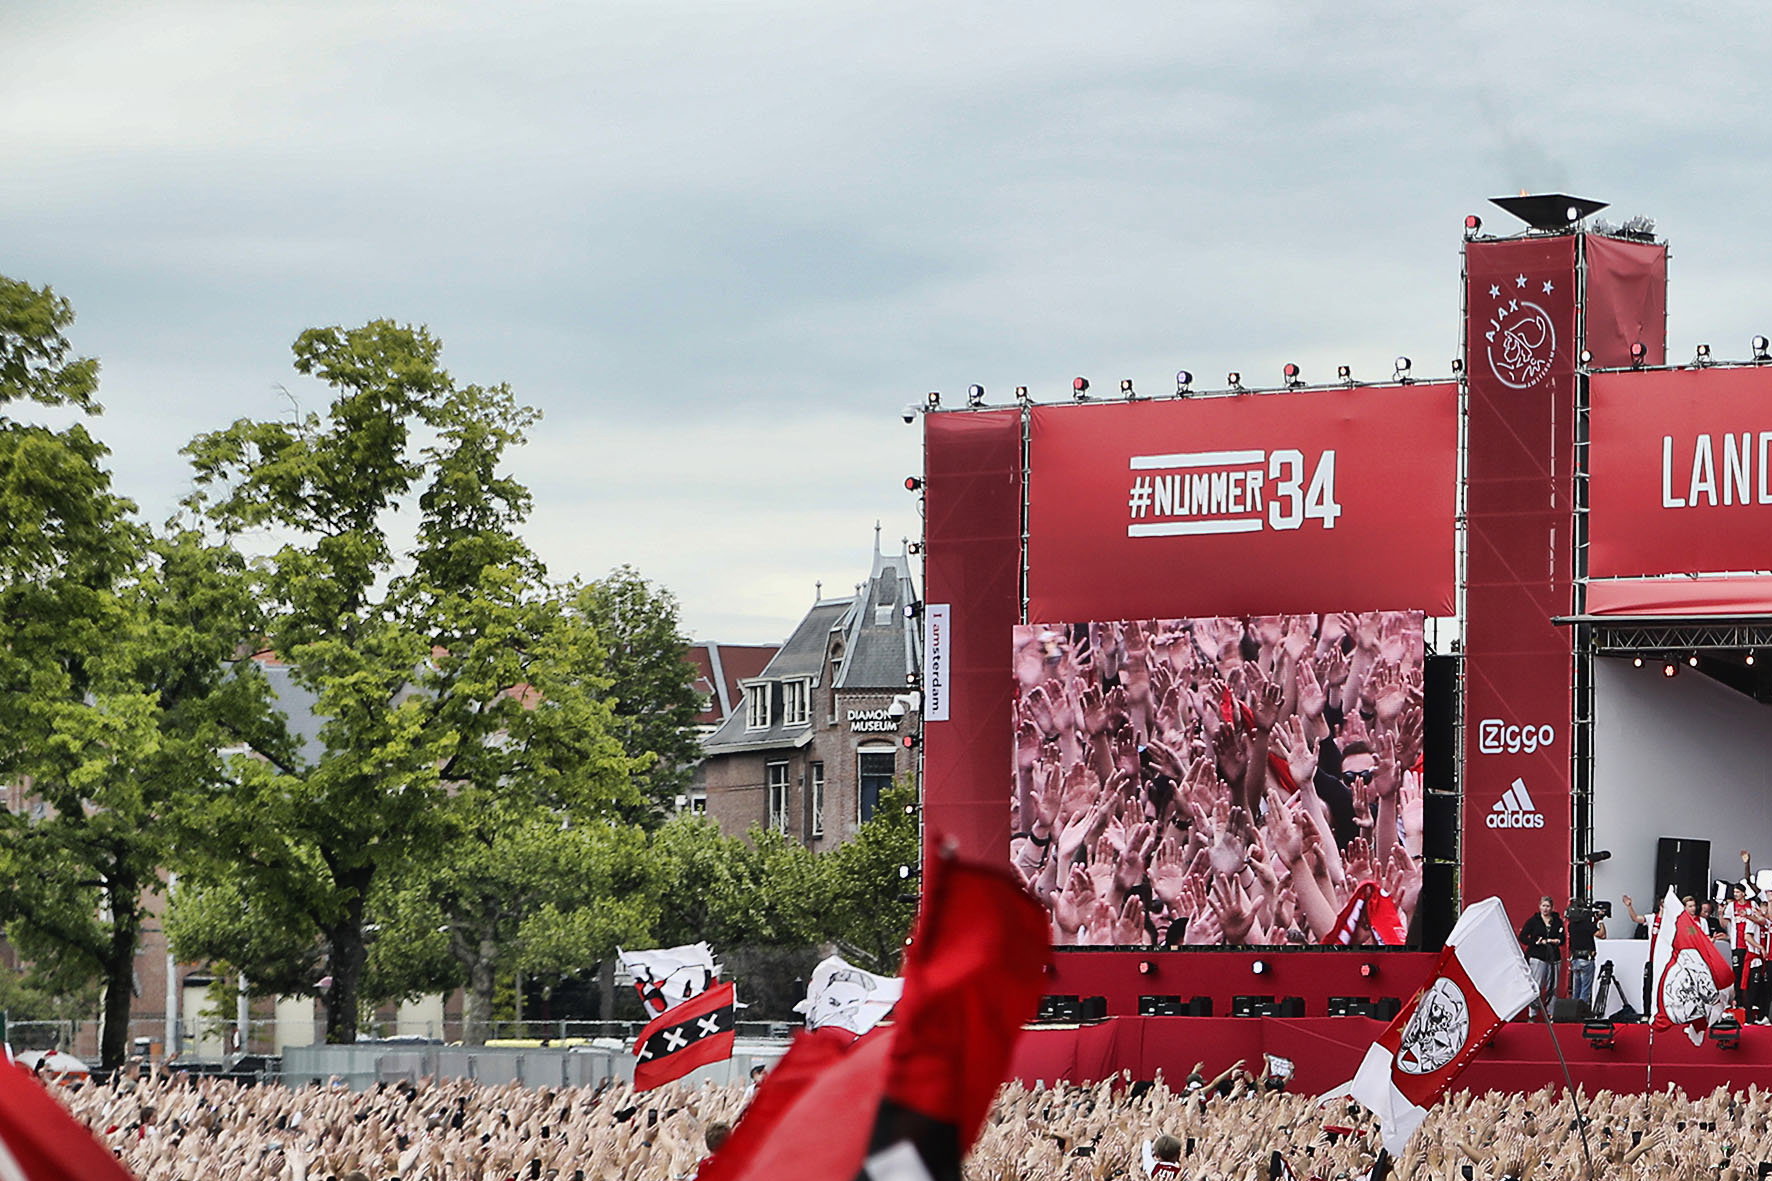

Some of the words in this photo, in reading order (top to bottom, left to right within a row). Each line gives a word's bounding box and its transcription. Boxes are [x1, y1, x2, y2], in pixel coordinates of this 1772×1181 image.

[1485, 298, 1519, 343] AJAX
[1526, 351, 1556, 389] AMSTERDAM
[847, 709, 893, 721] DIAMON
[850, 721, 898, 732] MUSEUM
[1485, 810, 1545, 828] adidas
